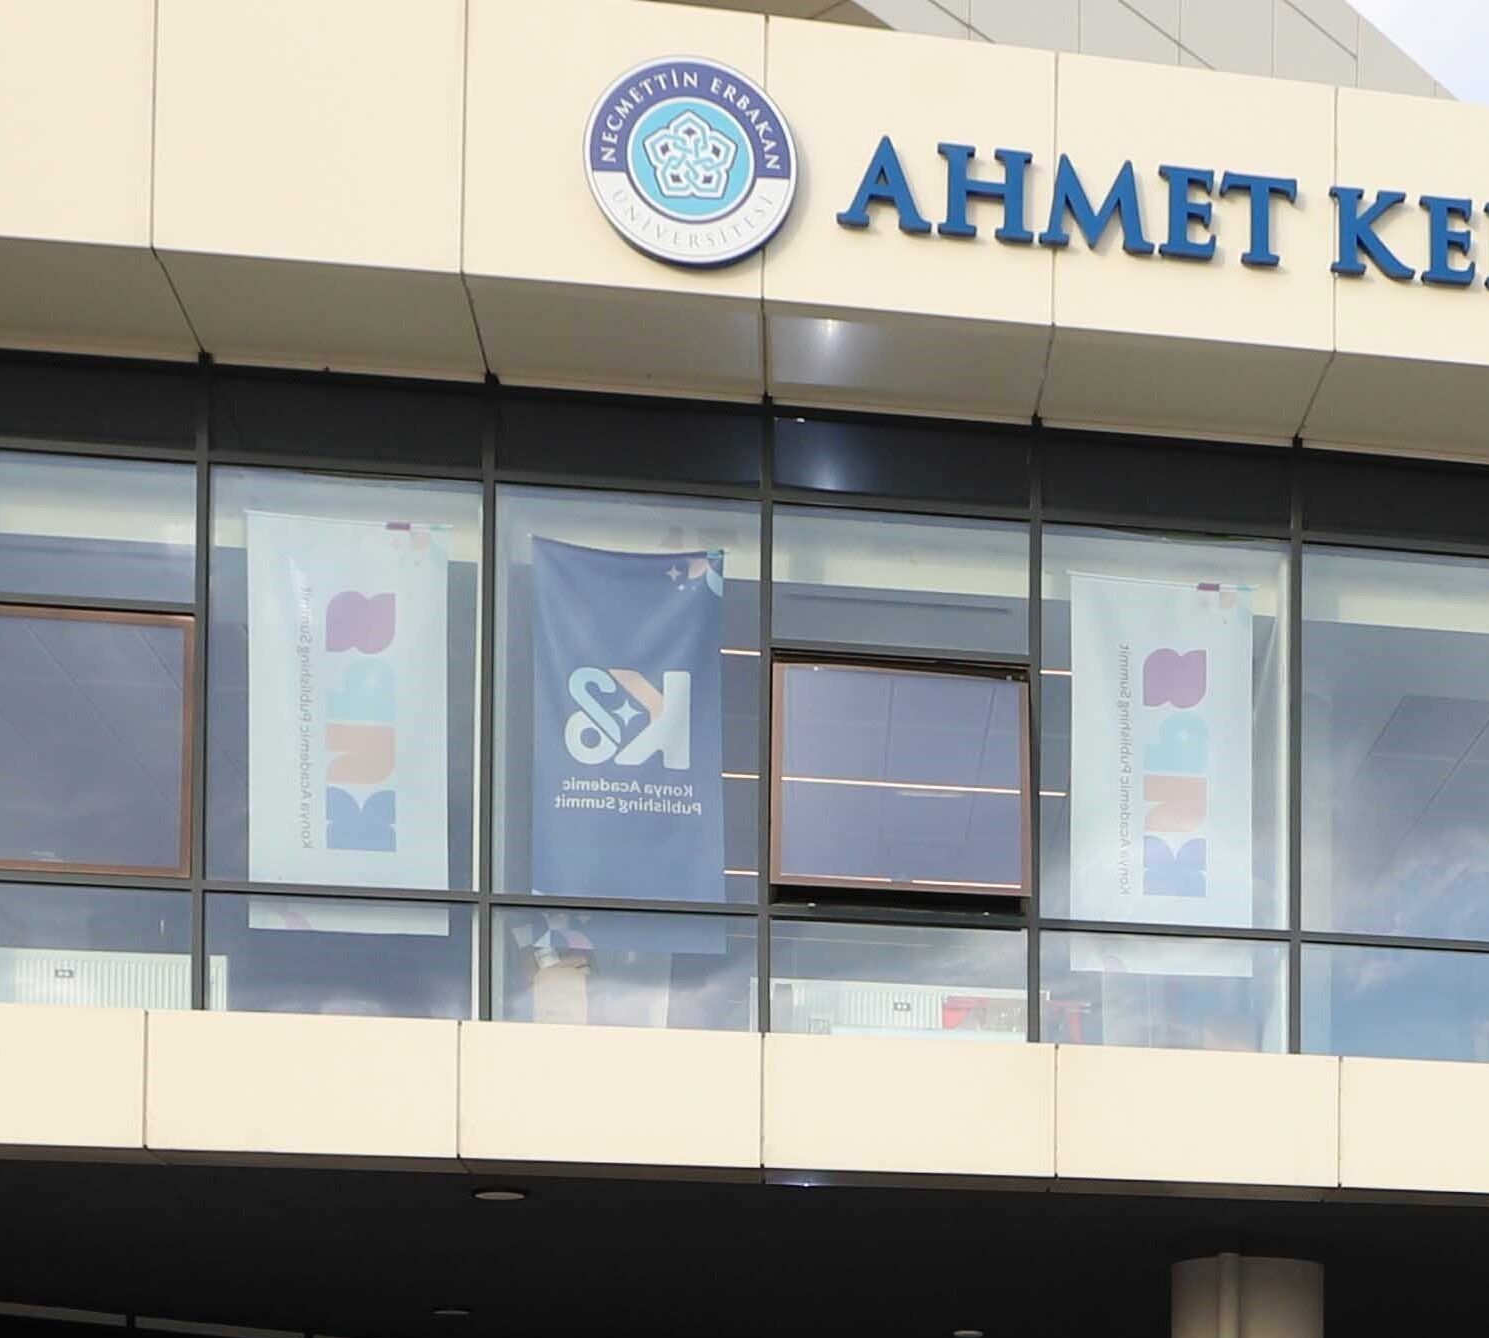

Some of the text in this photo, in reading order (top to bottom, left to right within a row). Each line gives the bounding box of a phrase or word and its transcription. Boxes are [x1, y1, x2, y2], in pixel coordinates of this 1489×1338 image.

[599, 67, 781, 171] NECMETTİN ERBAKAN
[837, 136, 1300, 268] AHMET
